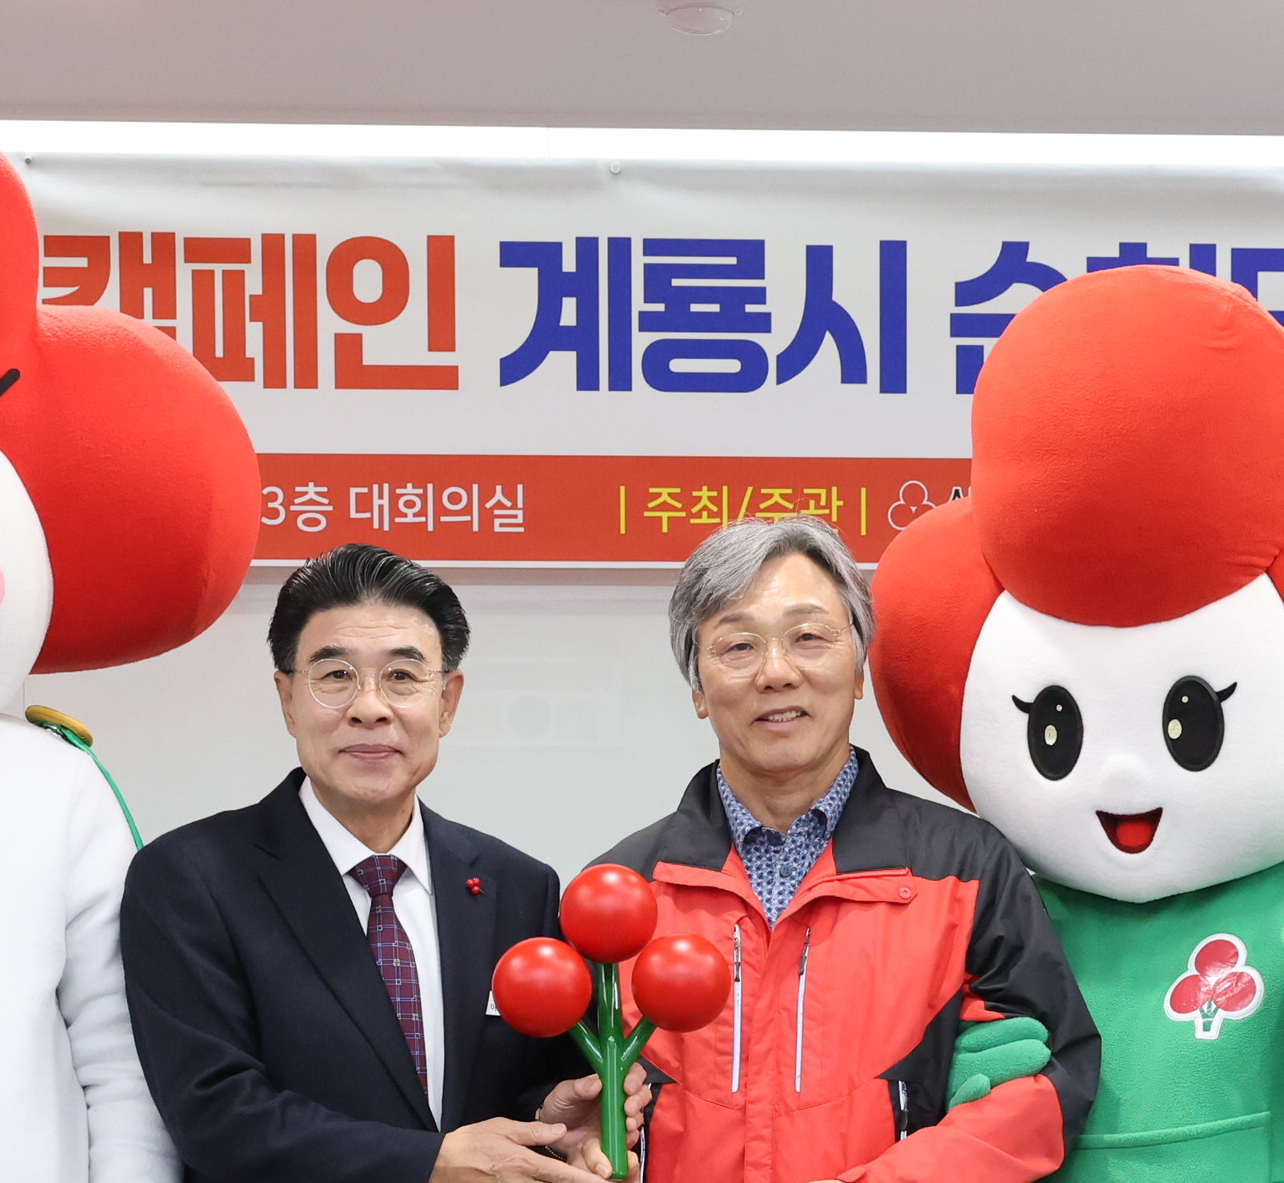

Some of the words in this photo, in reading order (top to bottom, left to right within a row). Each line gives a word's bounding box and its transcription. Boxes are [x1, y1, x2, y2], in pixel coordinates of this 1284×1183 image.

[499, 236, 908, 393] 계룡시
[261, 482, 334, 532] 3층
[349, 482, 525, 533] 대회의실
